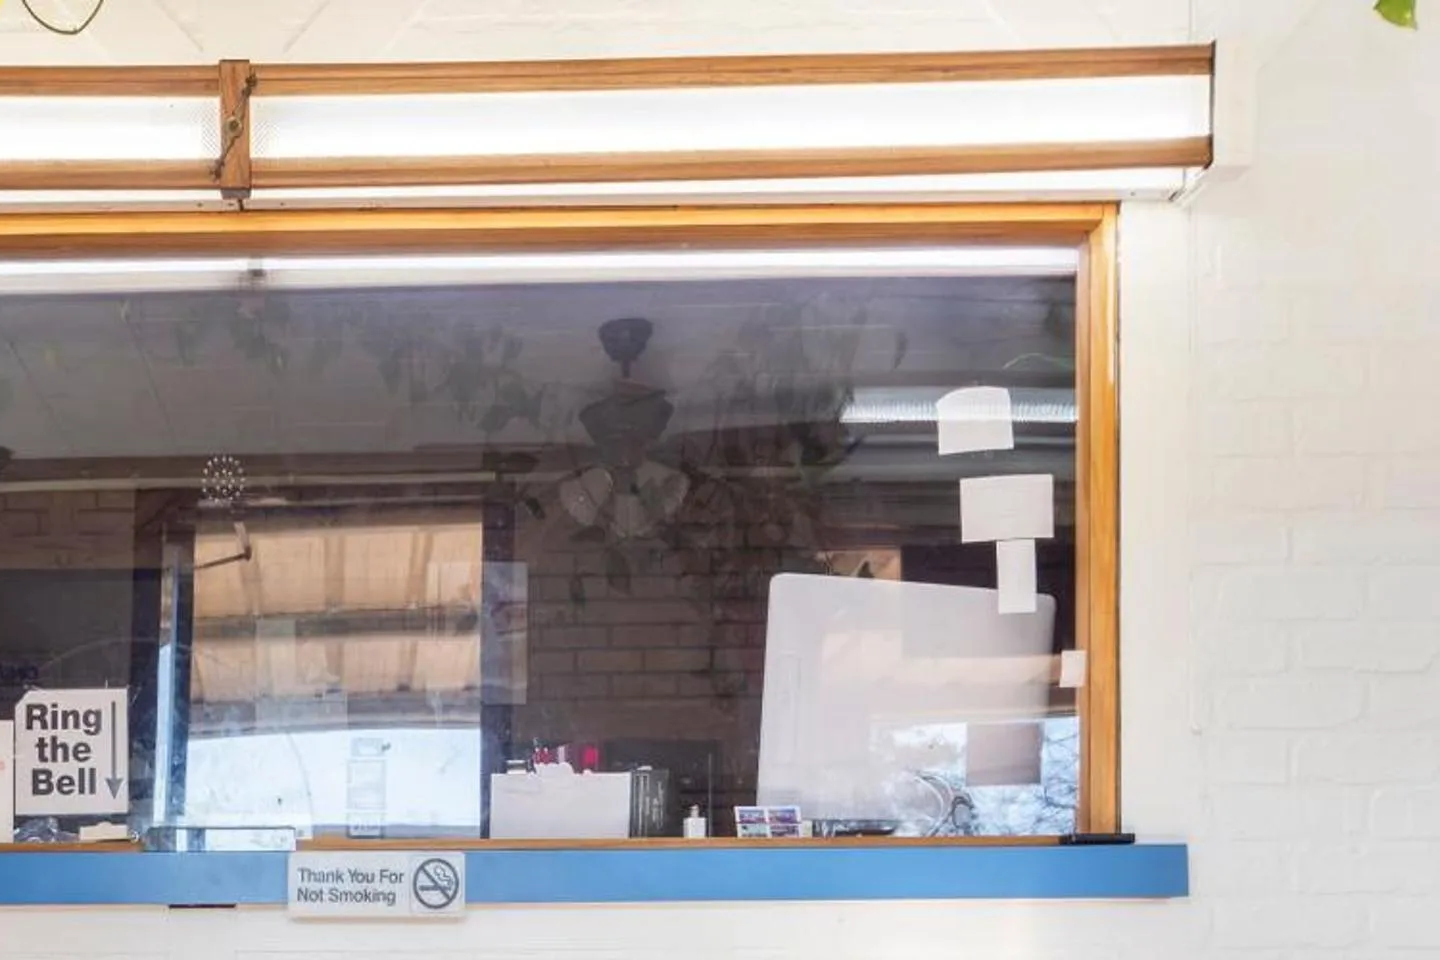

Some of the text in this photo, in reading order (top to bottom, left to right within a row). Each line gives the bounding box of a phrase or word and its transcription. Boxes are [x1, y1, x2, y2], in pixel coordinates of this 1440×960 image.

[26, 703, 102, 736] Ring
[35, 735, 92, 763] the
[32, 768, 97, 796] Bell
[297, 867, 405, 884] Thank You For
[297, 887, 397, 907] Not Smoking
